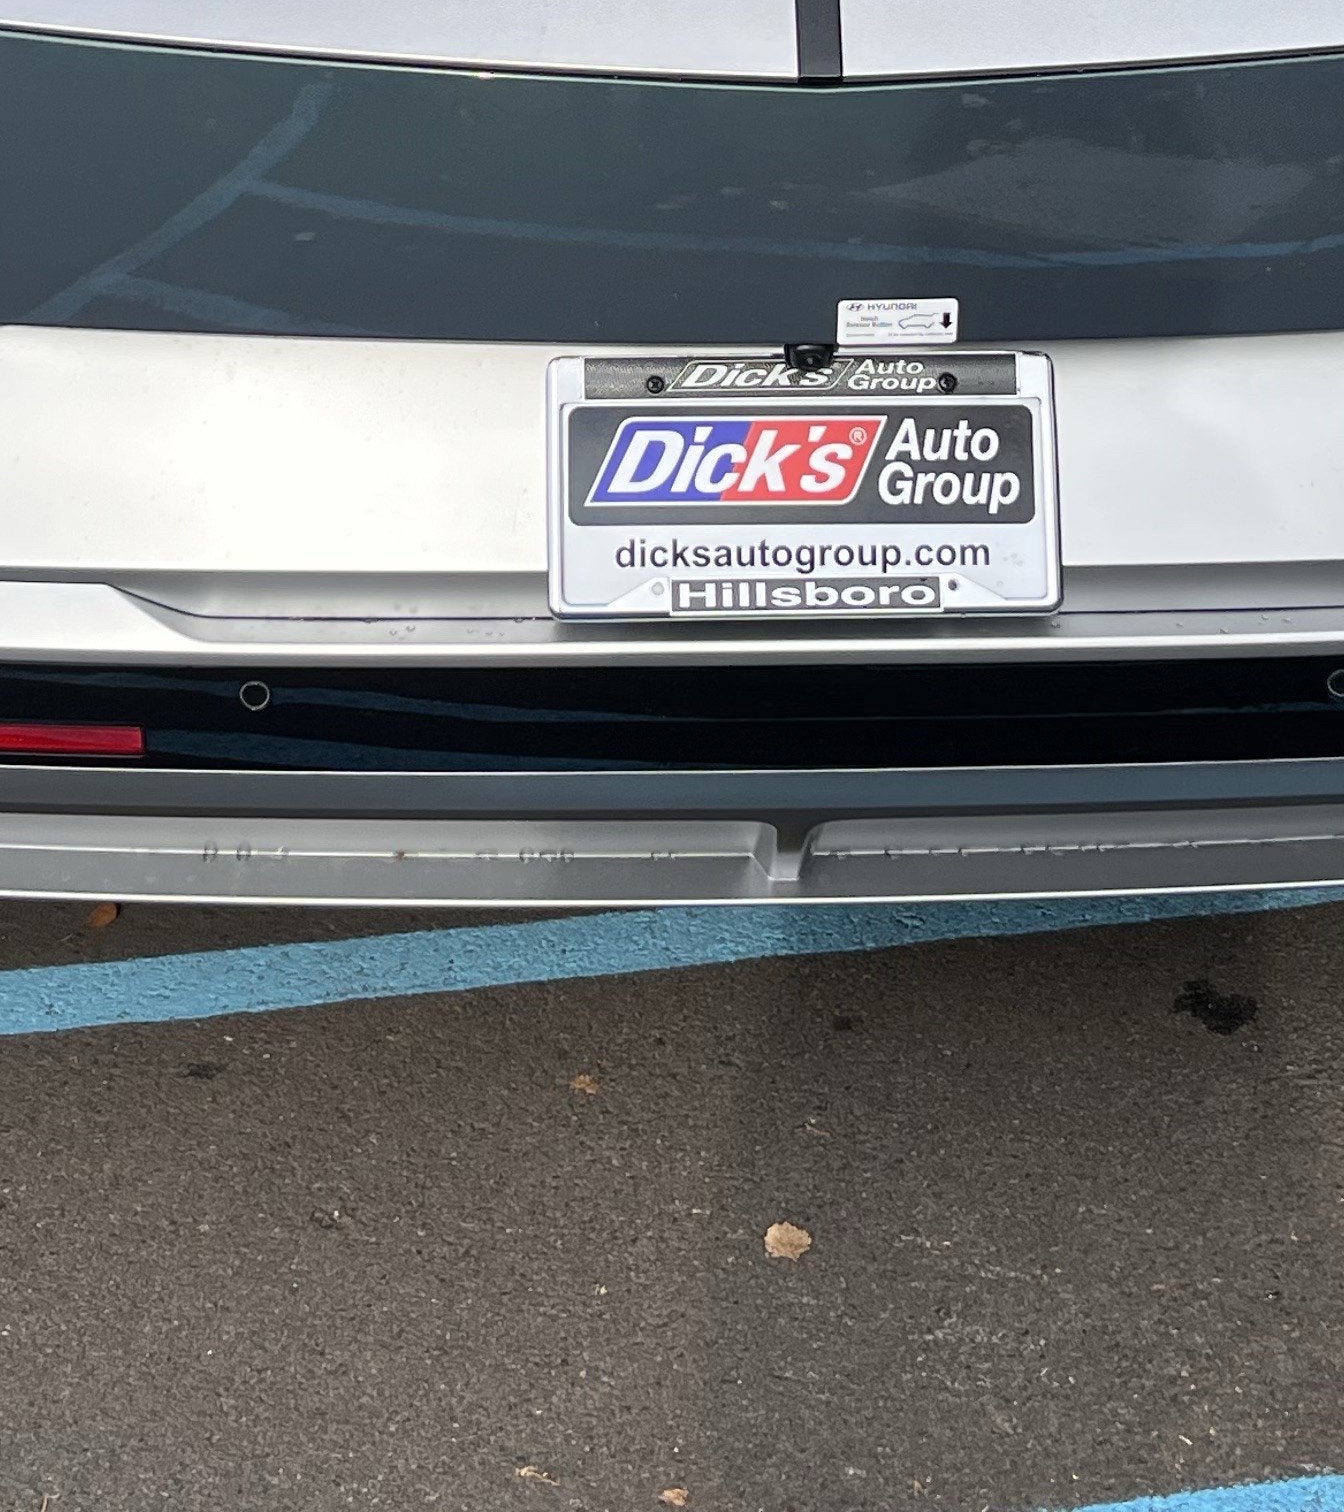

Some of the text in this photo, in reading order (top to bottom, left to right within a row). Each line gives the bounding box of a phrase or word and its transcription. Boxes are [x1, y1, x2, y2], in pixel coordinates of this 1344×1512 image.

[867, 302, 918, 311] HYUNDAI
[681, 363, 833, 388] Dicks
[855, 358, 924, 375] Auto
[847, 374, 937, 393] Group
[884, 418, 1000, 462] Auto
[878, 461, 1021, 514] Group
[615, 538, 991, 574] dicksautogroup.com
[678, 581, 937, 609] Hillsboro
